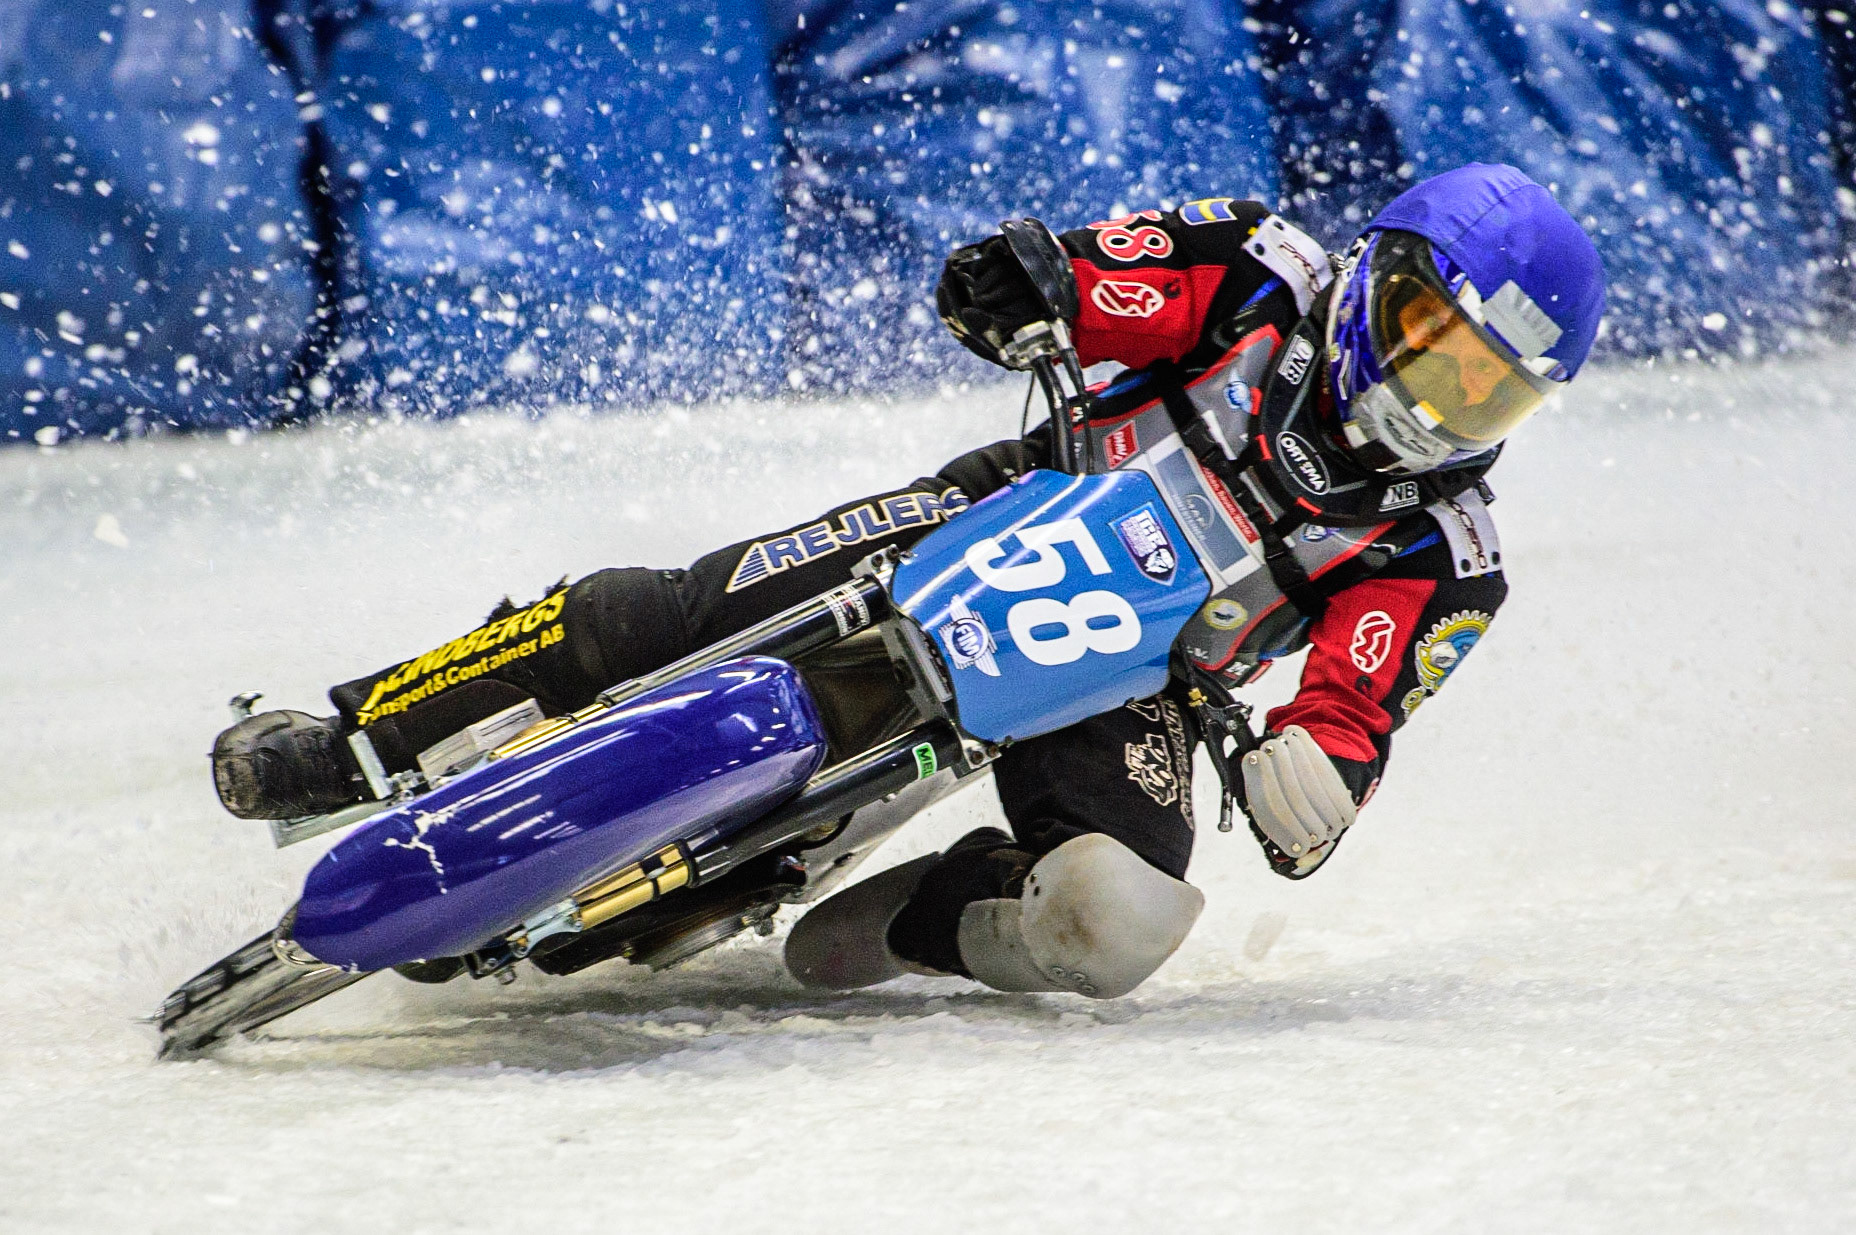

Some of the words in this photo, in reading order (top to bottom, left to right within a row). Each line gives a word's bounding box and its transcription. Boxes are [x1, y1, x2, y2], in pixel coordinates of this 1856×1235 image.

[1281, 437, 1326, 490] ORTEMA
[762, 485, 972, 570] REJLERS
[965, 517, 1141, 666] 58
[540, 623, 565, 649] AB
[955, 623, 985, 659] FIM
